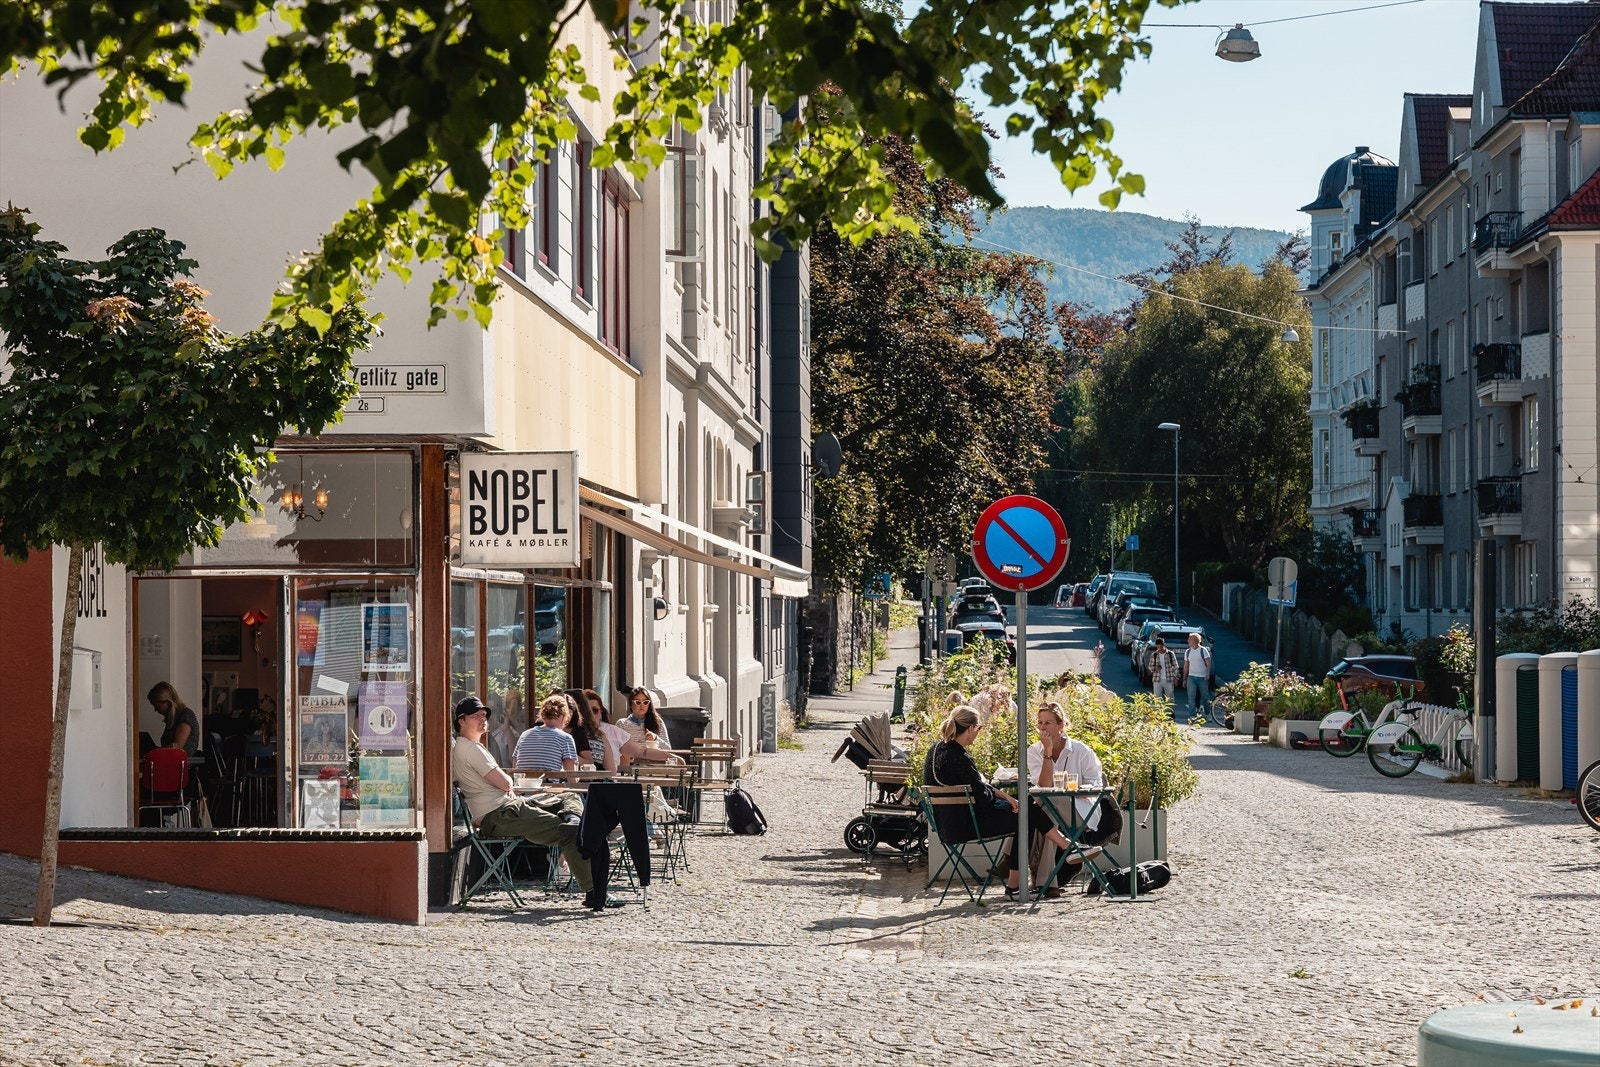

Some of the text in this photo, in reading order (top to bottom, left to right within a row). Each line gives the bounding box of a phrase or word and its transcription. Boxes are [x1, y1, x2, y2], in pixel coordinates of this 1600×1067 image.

[406, 368, 438, 390] gate
[358, 399, 369, 411] 2B
[469, 469, 568, 505] NOBEL
[469, 537, 568, 548] KAFÉ & MØBLER
[301, 697, 346, 706] EMBLA
[304, 753, 345, 761] 17.09.22
